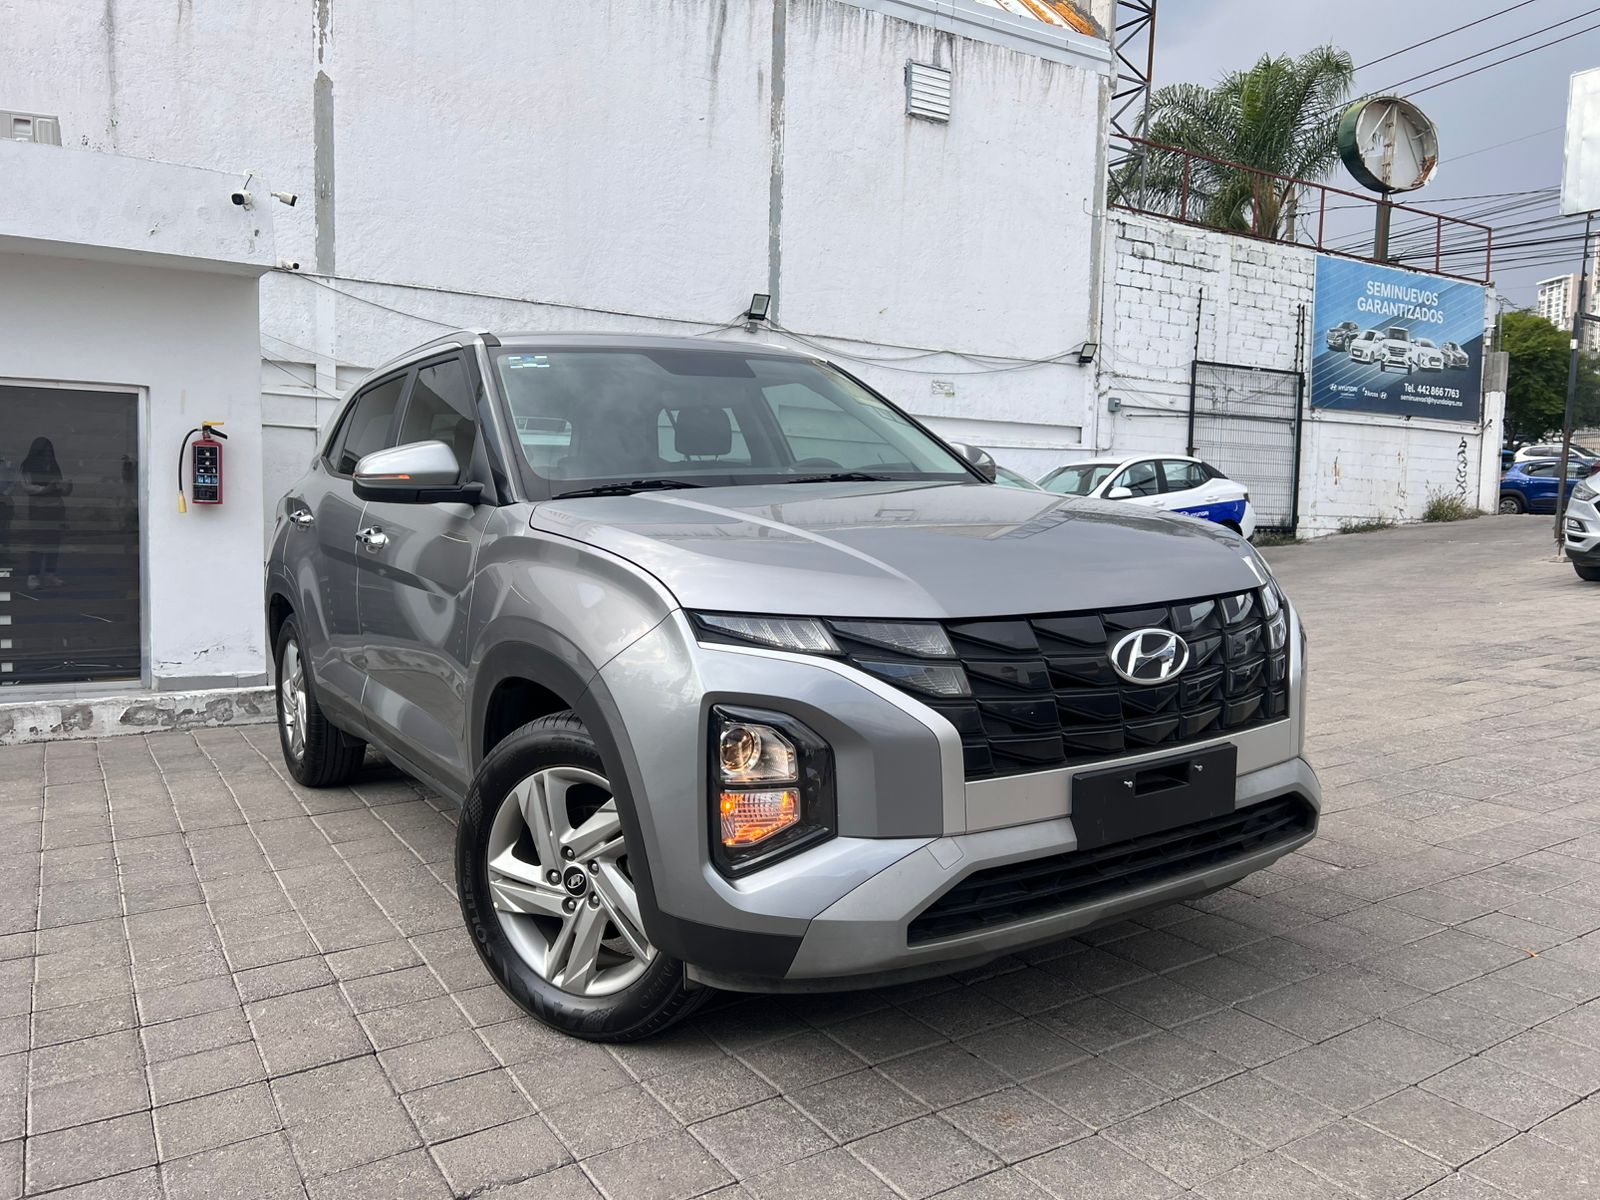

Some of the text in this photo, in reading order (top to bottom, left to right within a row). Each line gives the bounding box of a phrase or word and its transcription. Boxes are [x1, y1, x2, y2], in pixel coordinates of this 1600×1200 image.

[1366, 280, 1439, 307] SEMINUEVOS
[1357, 296, 1444, 324] GARANTIZADOS
[1404, 382, 1416, 393] Tel.
[1417, 384, 1430, 395] 442
[1444, 387, 1460, 399] 7763
[462, 878, 492, 958] SOLUS
